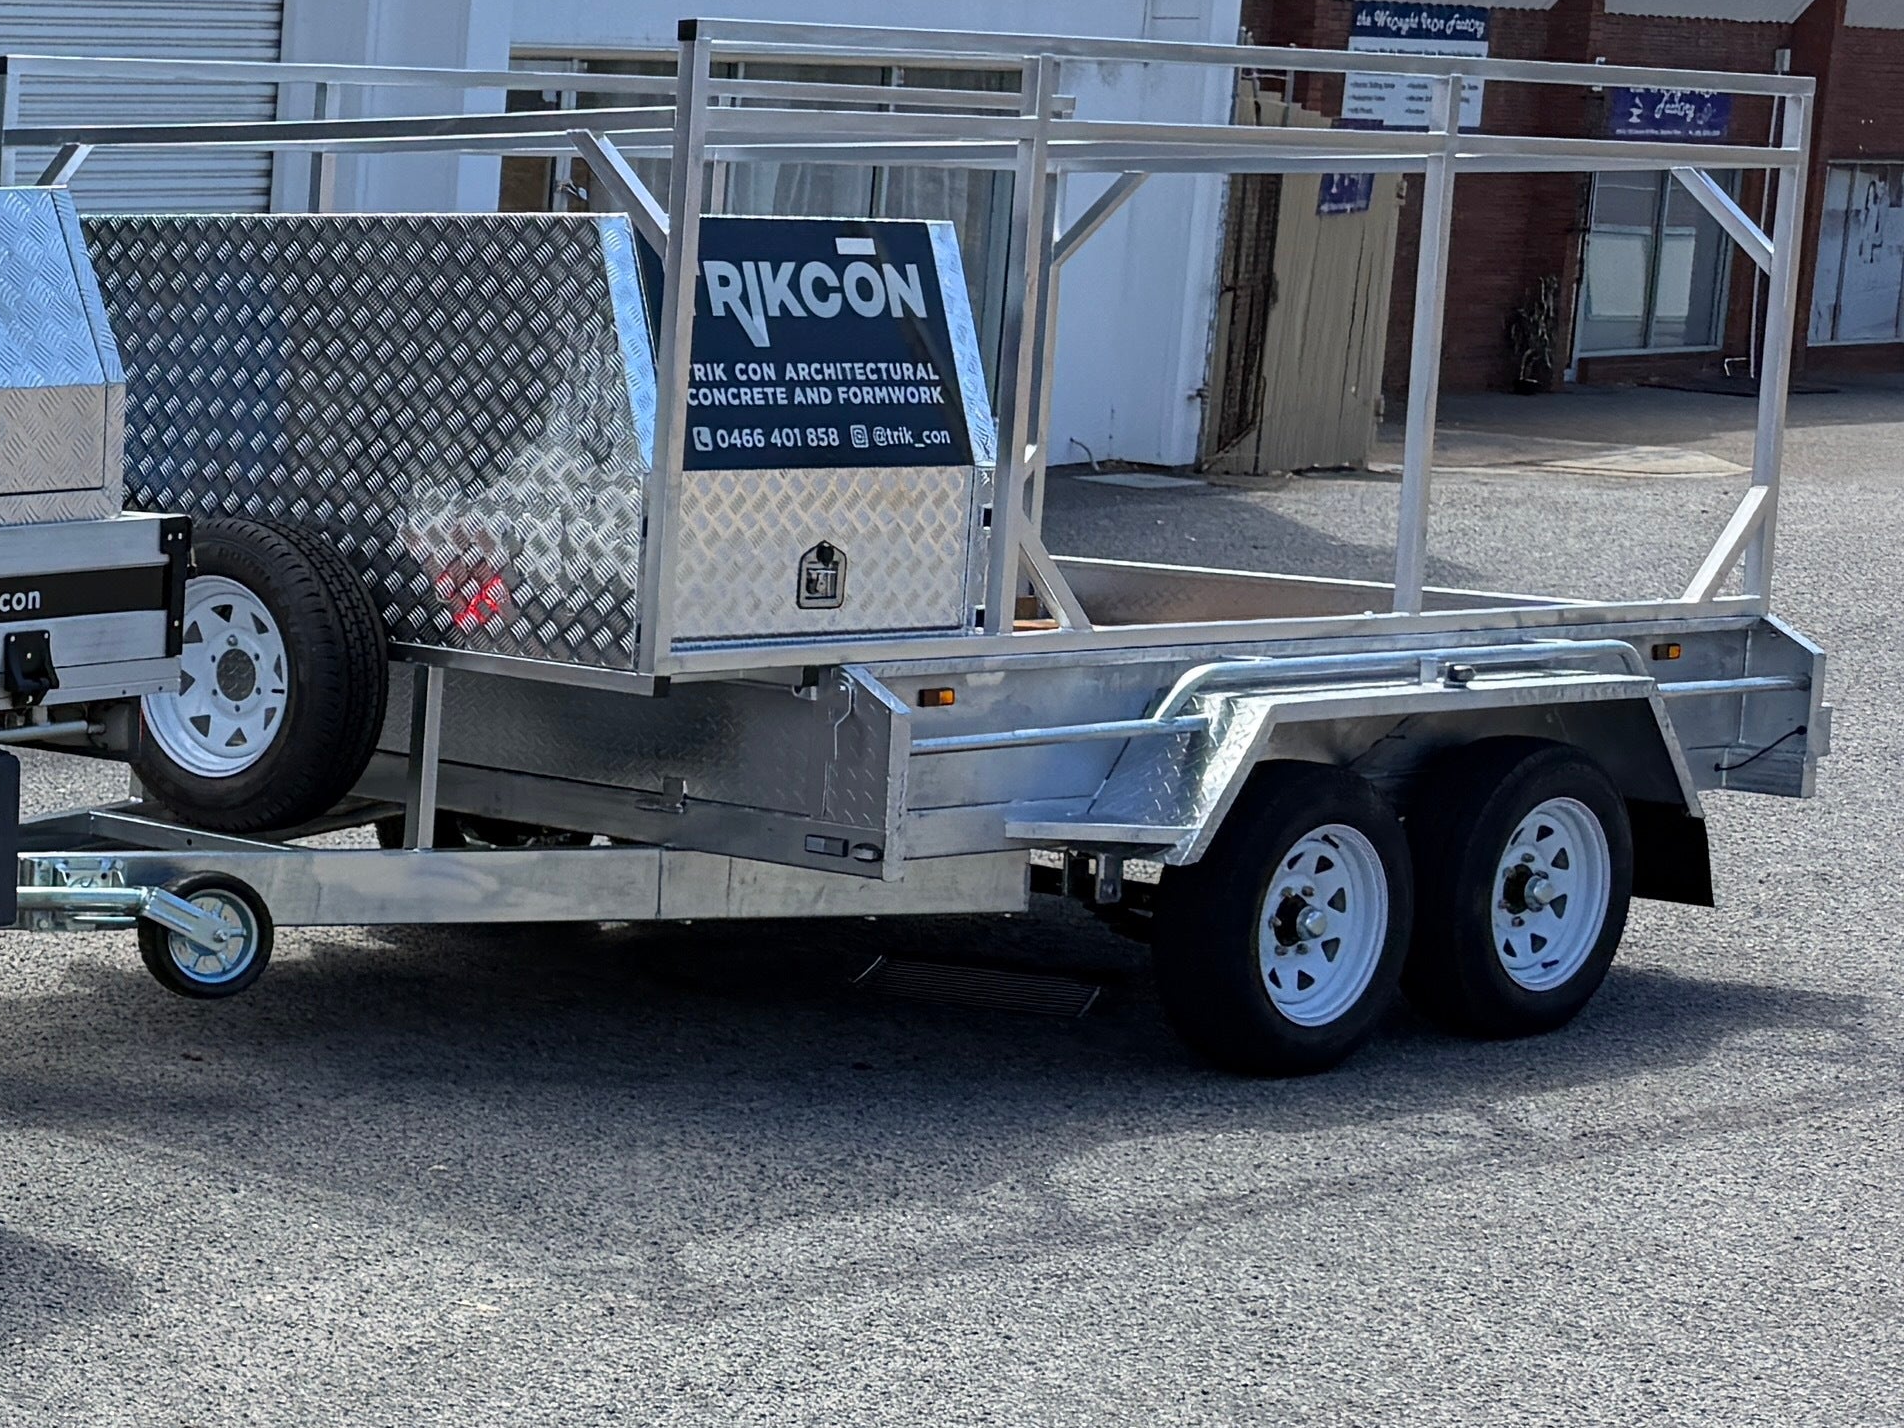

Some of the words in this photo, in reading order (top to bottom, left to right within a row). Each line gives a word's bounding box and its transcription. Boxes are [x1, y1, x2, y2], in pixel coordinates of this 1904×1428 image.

[690, 362, 728, 382] RIK
[734, 362, 777, 382] CON
[785, 362, 940, 381] ARCHITECTURAL
[687, 387, 789, 406] CONCRETE
[794, 387, 832, 405] AND
[837, 386, 945, 405] FORMWORK
[716, 428, 765, 449] 0466
[770, 427, 802, 447] 401
[806, 427, 840, 447] 858
[872, 425, 951, 449] @trik_con
